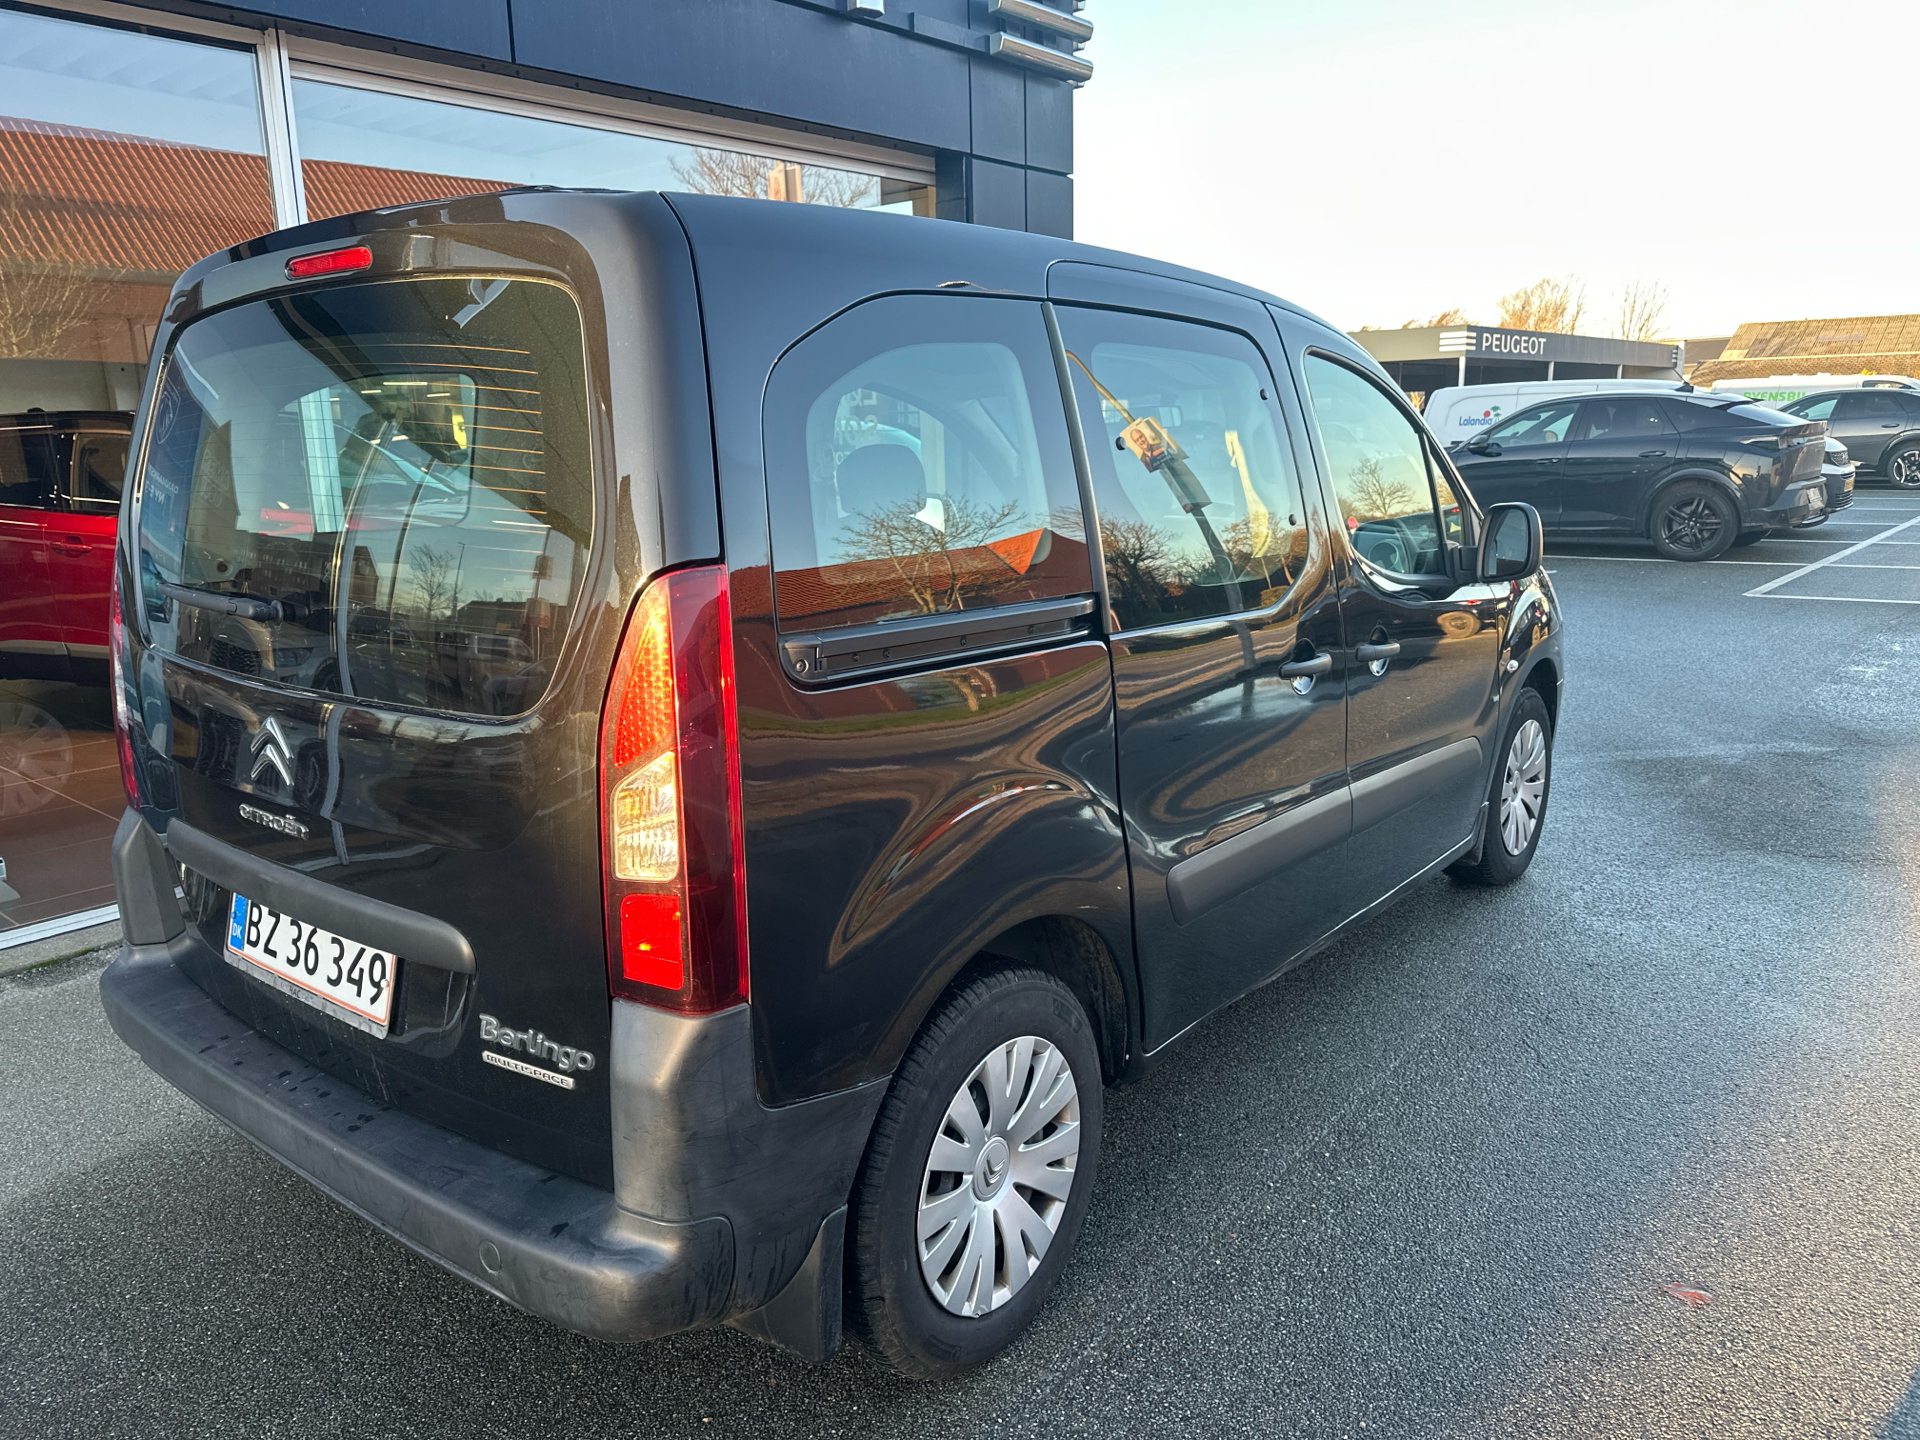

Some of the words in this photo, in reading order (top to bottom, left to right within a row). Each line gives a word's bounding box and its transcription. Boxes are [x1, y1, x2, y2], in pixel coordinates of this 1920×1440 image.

[1482, 332, 1547, 355] PEUGEOT
[1458, 415, 1493, 427] Lalandia
[232, 922, 243, 940] DK
[246, 901, 281, 959] BZ
[286, 918, 319, 977] 36
[326, 936, 387, 1006] 349
[479, 1013, 596, 1073] Berlingo
[485, 1053, 571, 1088] MULTISPACE
